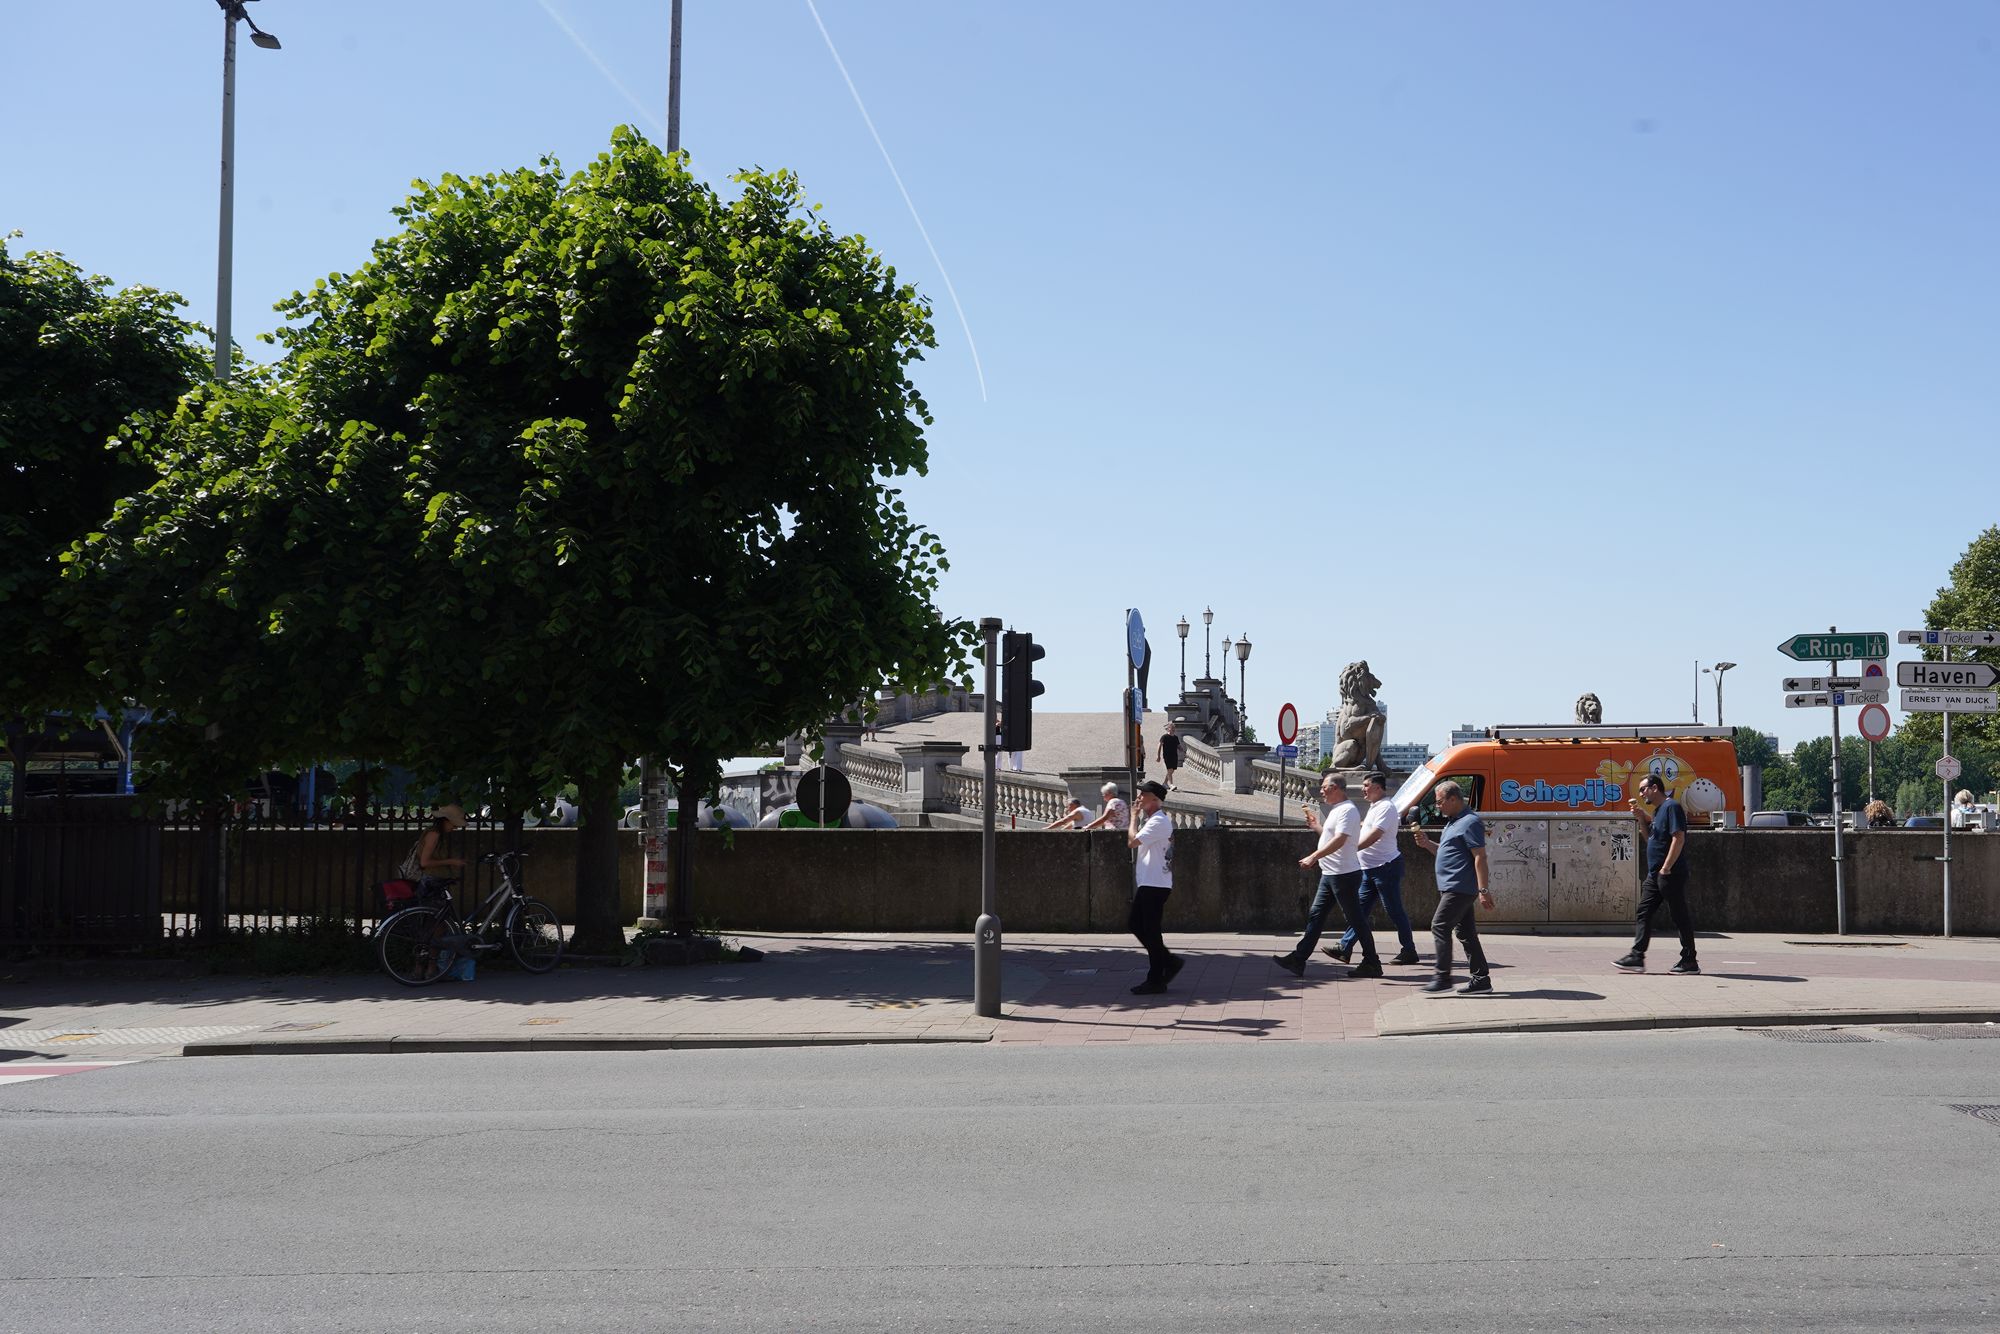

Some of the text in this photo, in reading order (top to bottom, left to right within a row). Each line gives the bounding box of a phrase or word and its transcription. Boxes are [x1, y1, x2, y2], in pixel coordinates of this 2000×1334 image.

[1928, 632, 1974, 644] P Ticket
[1809, 638, 1854, 659] Ring
[1913, 666, 1976, 685] Haven
[1849, 692, 1880, 704] Ticket
[1908, 695, 1941, 703] ERNEST
[1944, 696, 1962, 704] VAN
[1500, 779, 1622, 807] Schepijs
